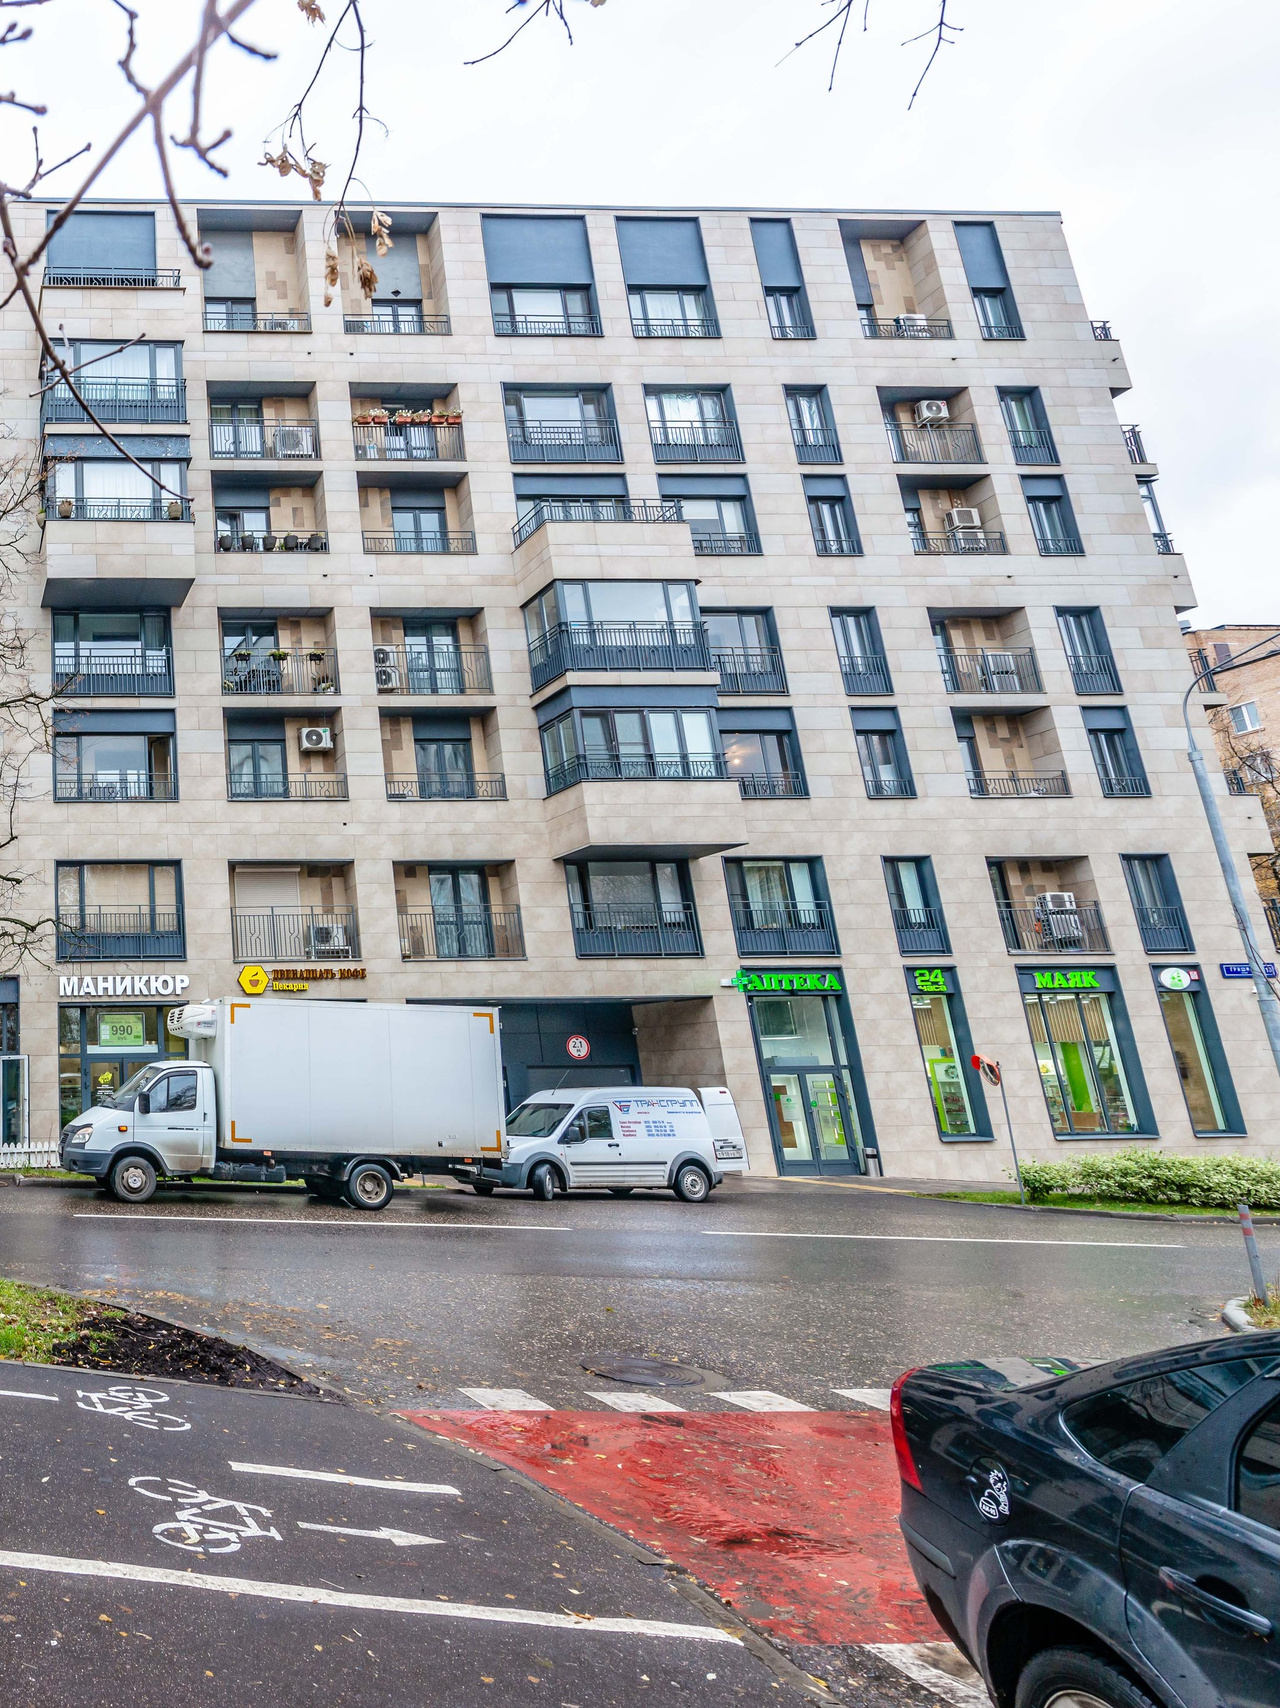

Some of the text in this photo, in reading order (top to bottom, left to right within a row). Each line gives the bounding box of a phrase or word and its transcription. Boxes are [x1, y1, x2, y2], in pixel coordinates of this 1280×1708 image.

[338, 968, 367, 980] КОФЕ
[915, 969, 945, 985] 24
[1034, 971, 1100, 989] МАЯК
[59, 975, 190, 996] МАНИКЮР
[272, 981, 309, 992] Пекарня
[748, 973, 841, 991] АПТЕКА
[919, 984, 947, 992] часа
[111, 1025, 133, 1036] 990
